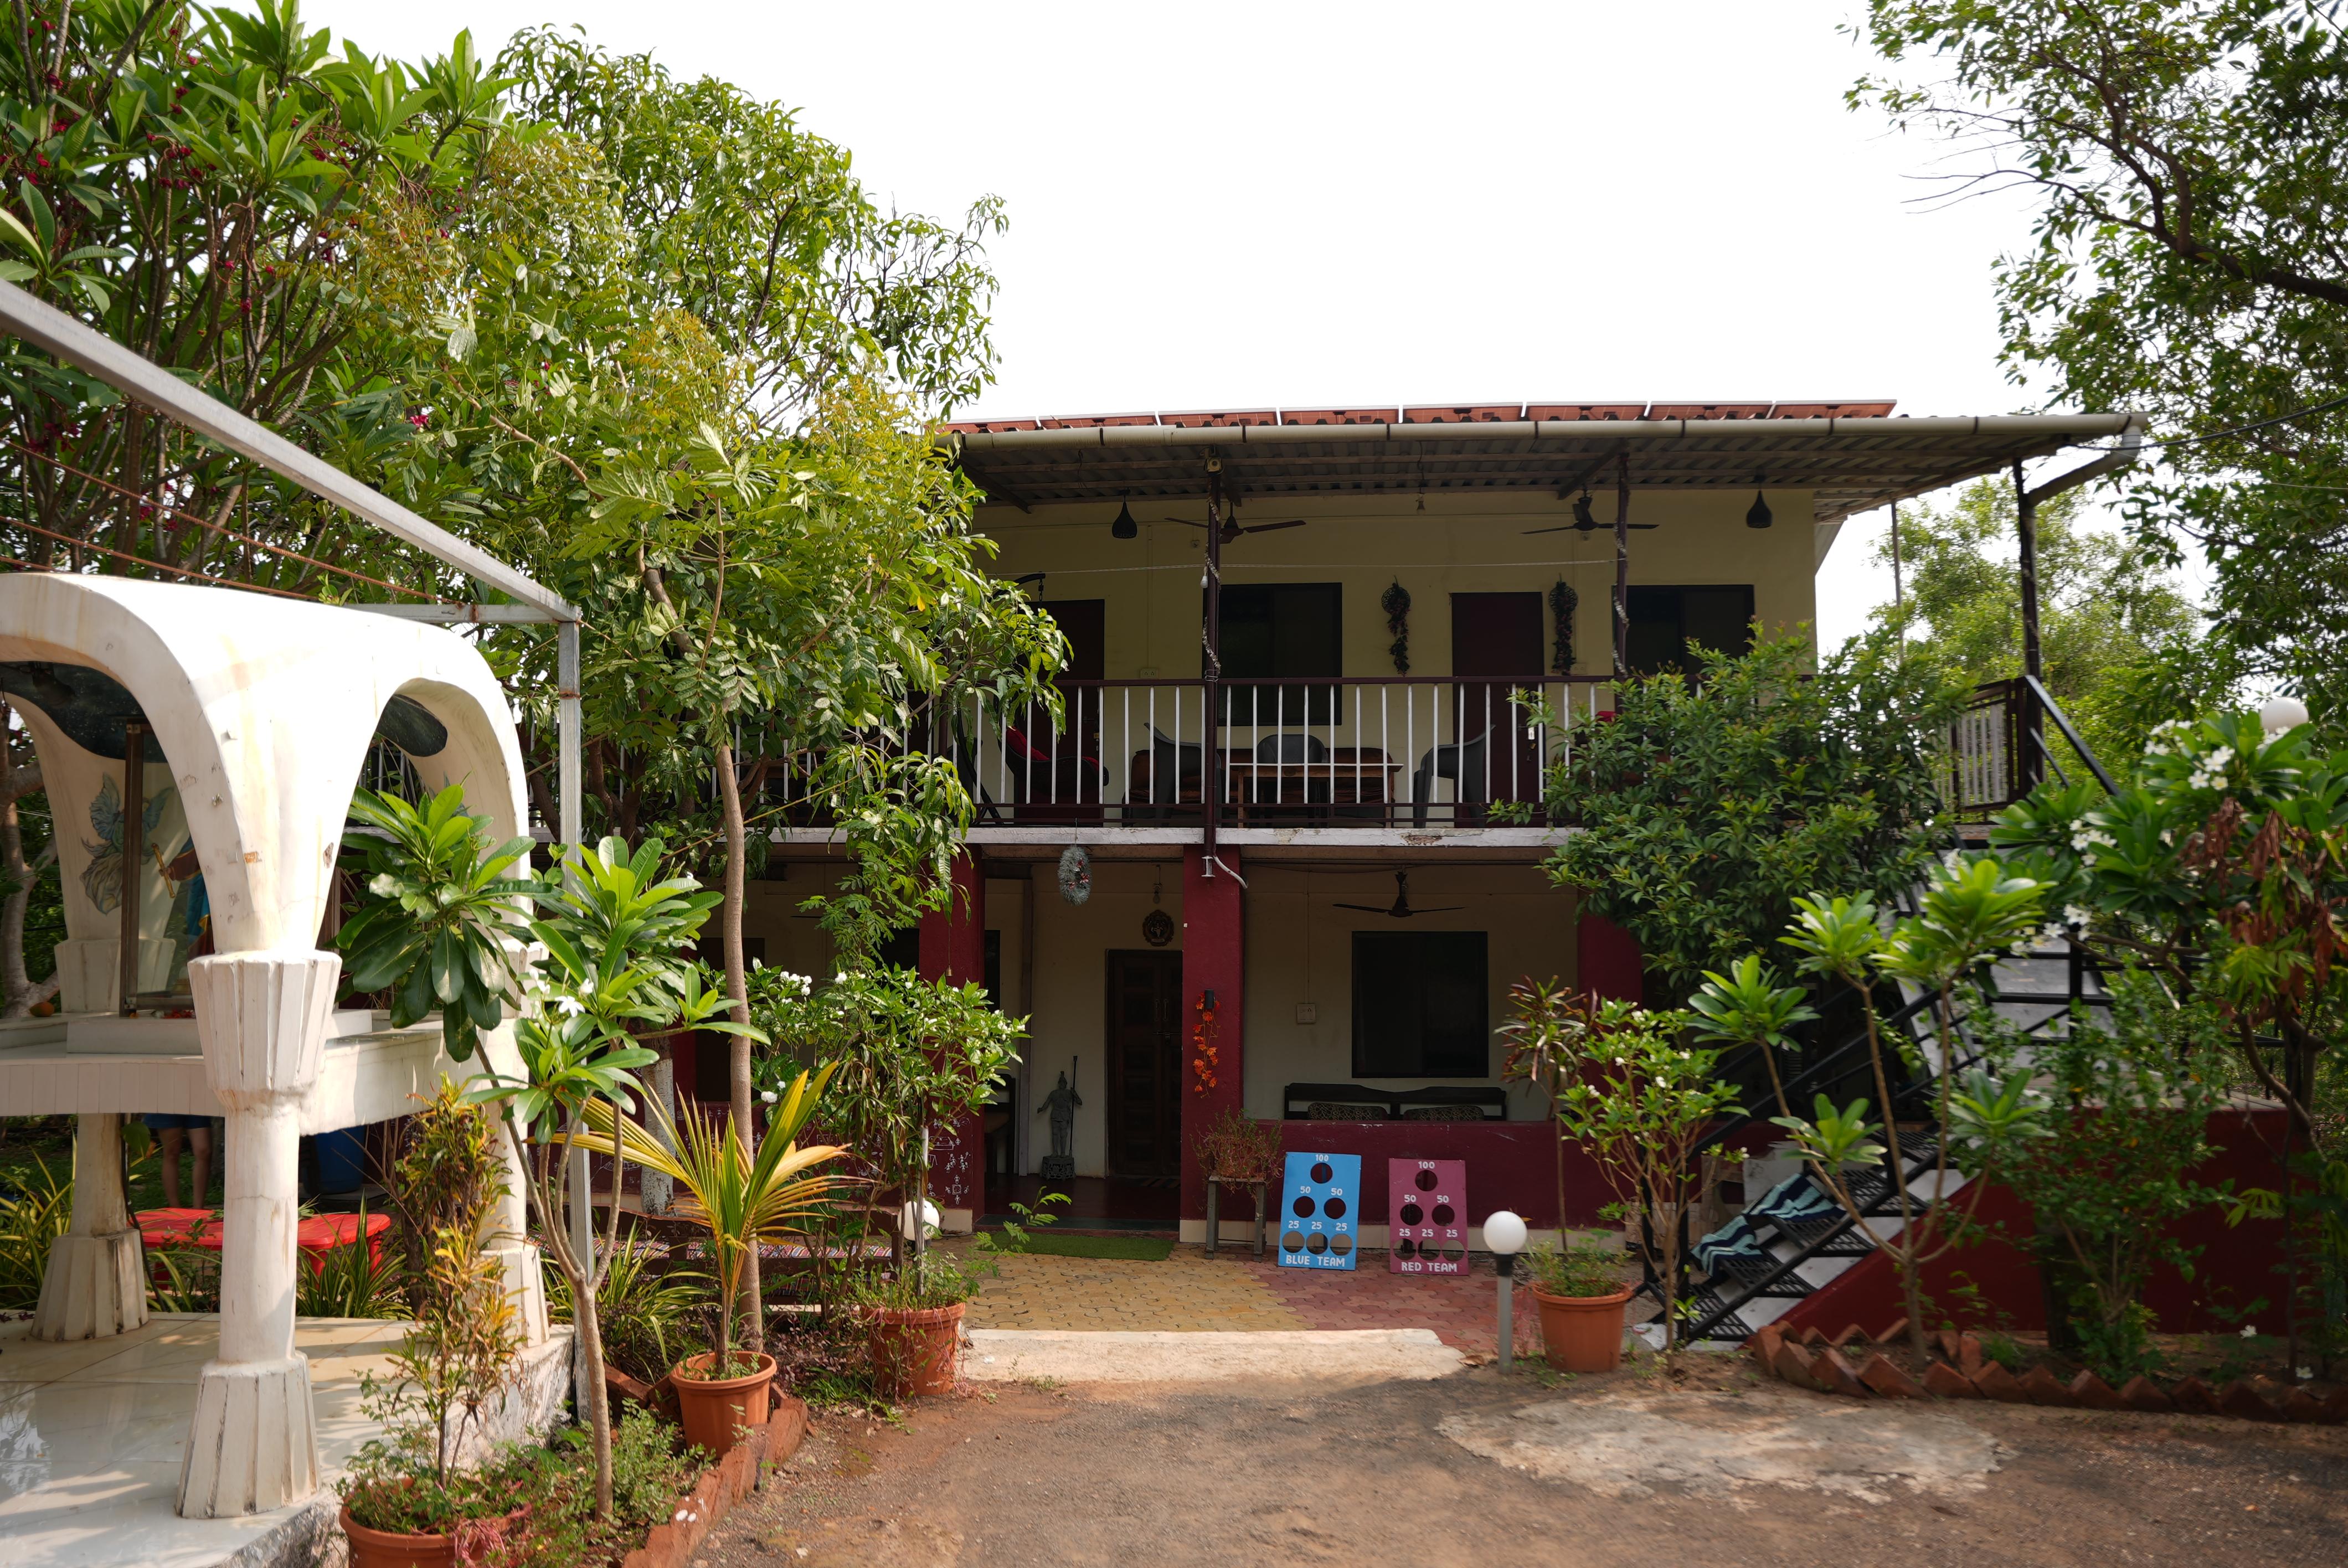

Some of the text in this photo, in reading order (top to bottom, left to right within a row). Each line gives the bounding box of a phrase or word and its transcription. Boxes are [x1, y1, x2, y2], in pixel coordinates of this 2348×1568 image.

[1315, 1153, 1329, 1162] 100
[1331, 1188, 1343, 1196] 50
[1404, 1194, 1449, 1203] 50 50
[1288, 1220, 1347, 1231] 25 25 25
[1399, 1228, 1458, 1237] 25 25 25
[1286, 1255, 1345, 1267] BLUE TEAM
[1401, 1261, 1457, 1272] RED TEAM
